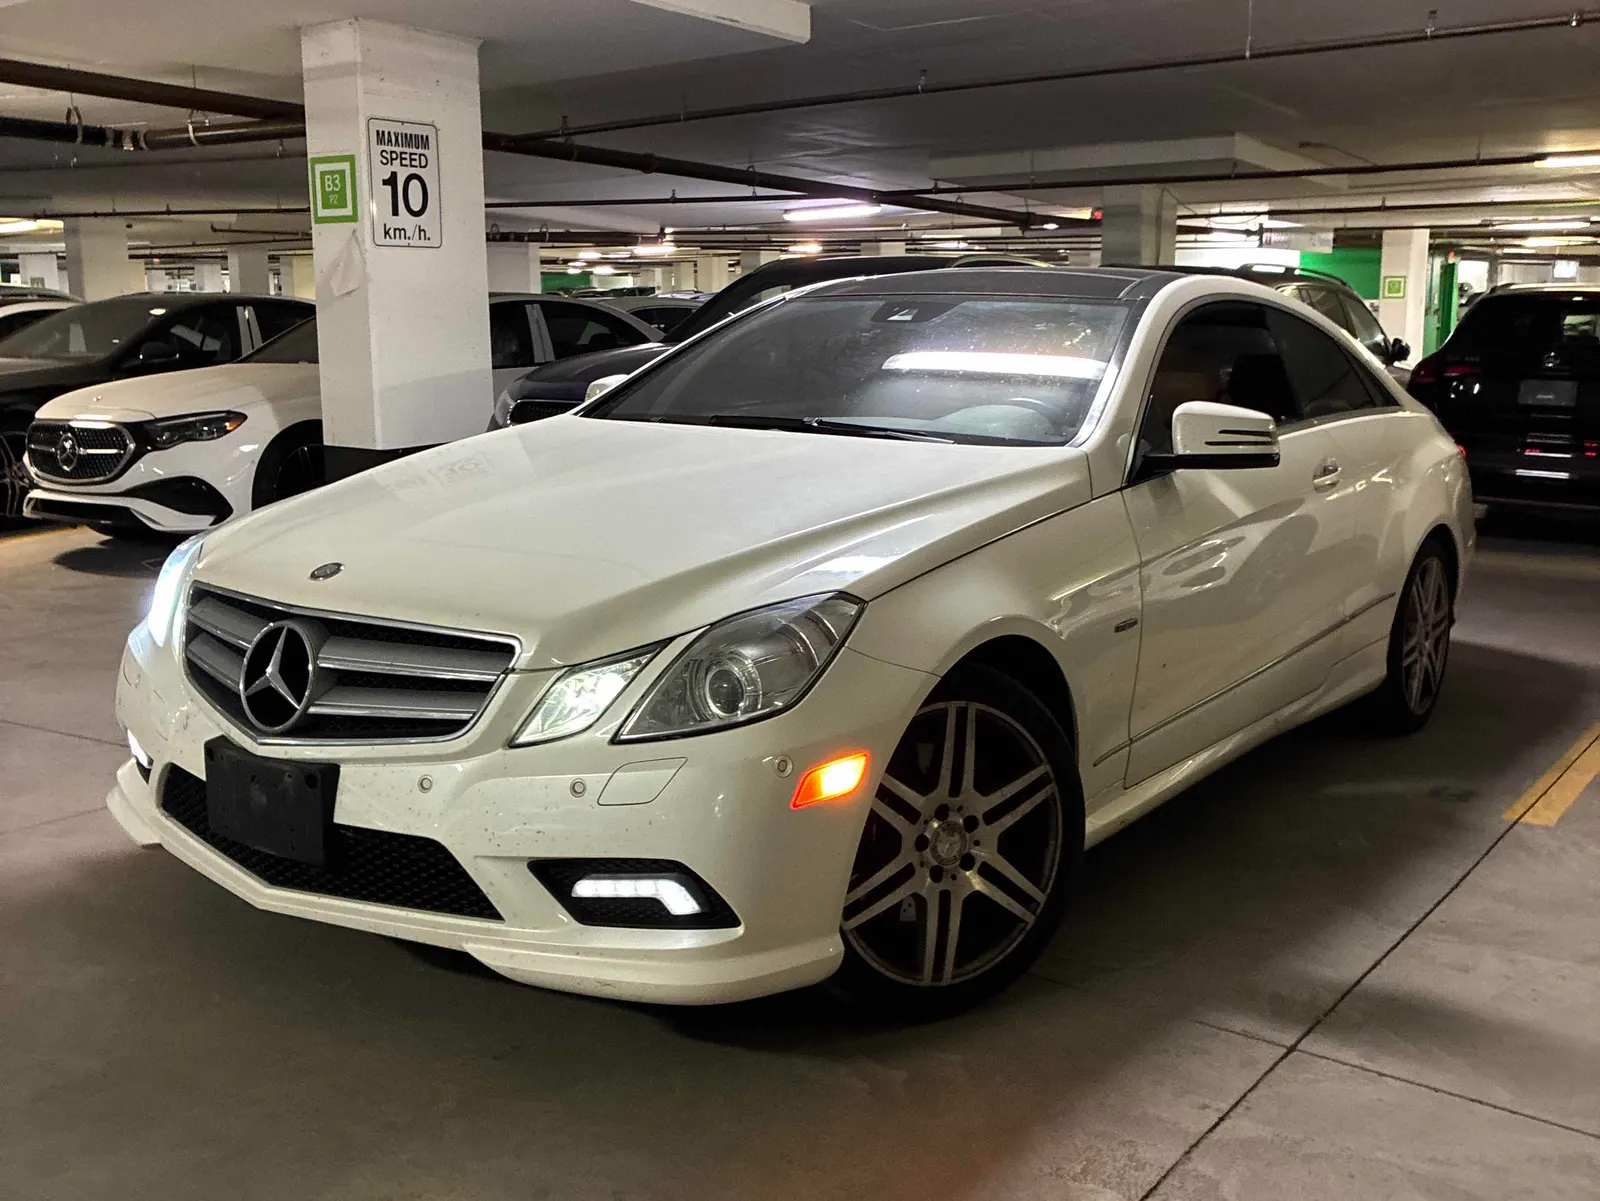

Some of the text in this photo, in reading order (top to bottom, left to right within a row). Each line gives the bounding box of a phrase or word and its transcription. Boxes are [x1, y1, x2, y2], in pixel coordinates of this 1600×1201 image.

[376, 130, 430, 151] MAXIMUM
[379, 150, 429, 169] SPEED
[324, 174, 341, 192] B3
[382, 171, 429, 218] 10
[383, 223, 431, 241] km./h.
